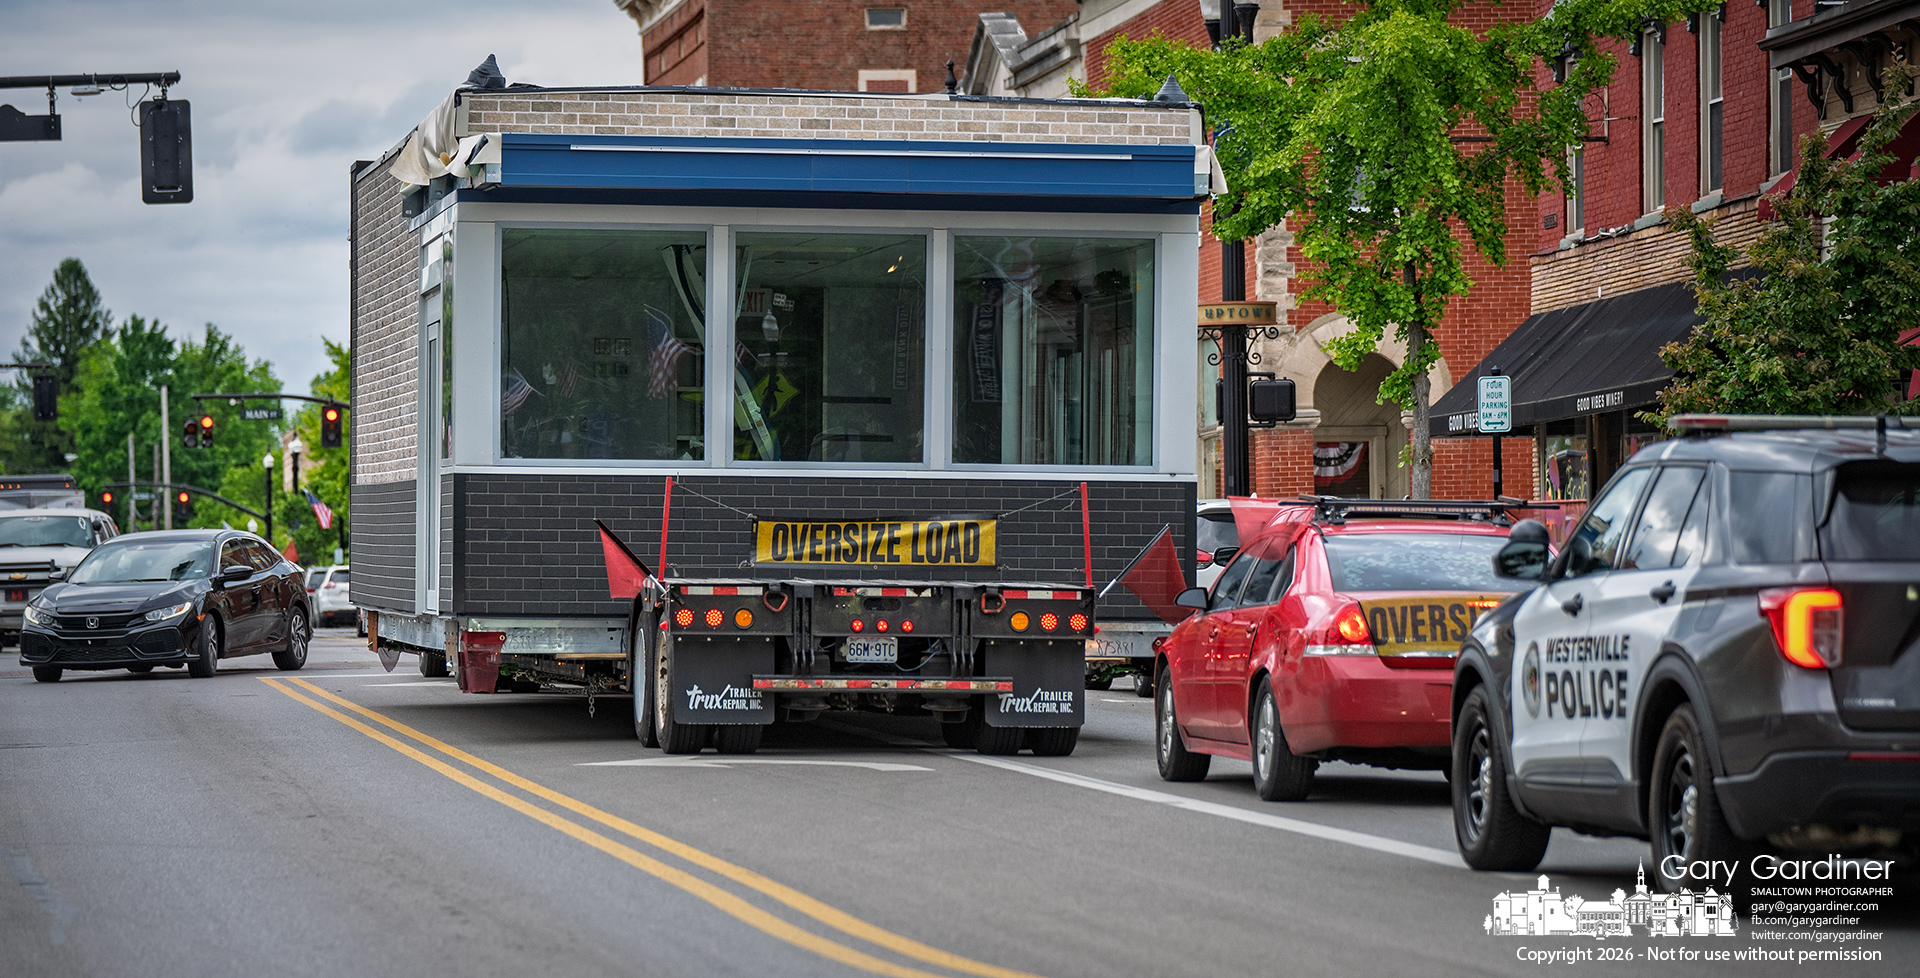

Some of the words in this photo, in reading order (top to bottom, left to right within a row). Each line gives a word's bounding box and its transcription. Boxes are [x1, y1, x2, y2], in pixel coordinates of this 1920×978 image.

[1205, 307, 1272, 319] UPTOWN
[1486, 381, 1503, 389] FOUR
[1486, 391, 1503, 399] HOUR
[1481, 401, 1508, 409] PARKING
[1577, 397, 1590, 412] GOOD
[1591, 394, 1605, 409] VIBES
[1605, 391, 1624, 407] WINERY
[245, 409, 269, 419] MAIN
[1448, 414, 1463, 431] GOOD
[771, 523, 902, 563] OVERSIZE
[911, 521, 981, 564] LOAD
[1369, 603, 1488, 646] OVERSI
[1095, 638, 1134, 656] 875881
[1546, 634, 1630, 663] WESTERVILLE
[729, 687, 763, 698] TRAILER
[1040, 691, 1073, 702] TRAILER
[1545, 669, 1628, 720] POLICE
[722, 699, 749, 710] REPAIR,
[749, 699, 763, 709] INC.
[1033, 702, 1059, 713] REPAIR,
[1060, 702, 1074, 713] INC.
